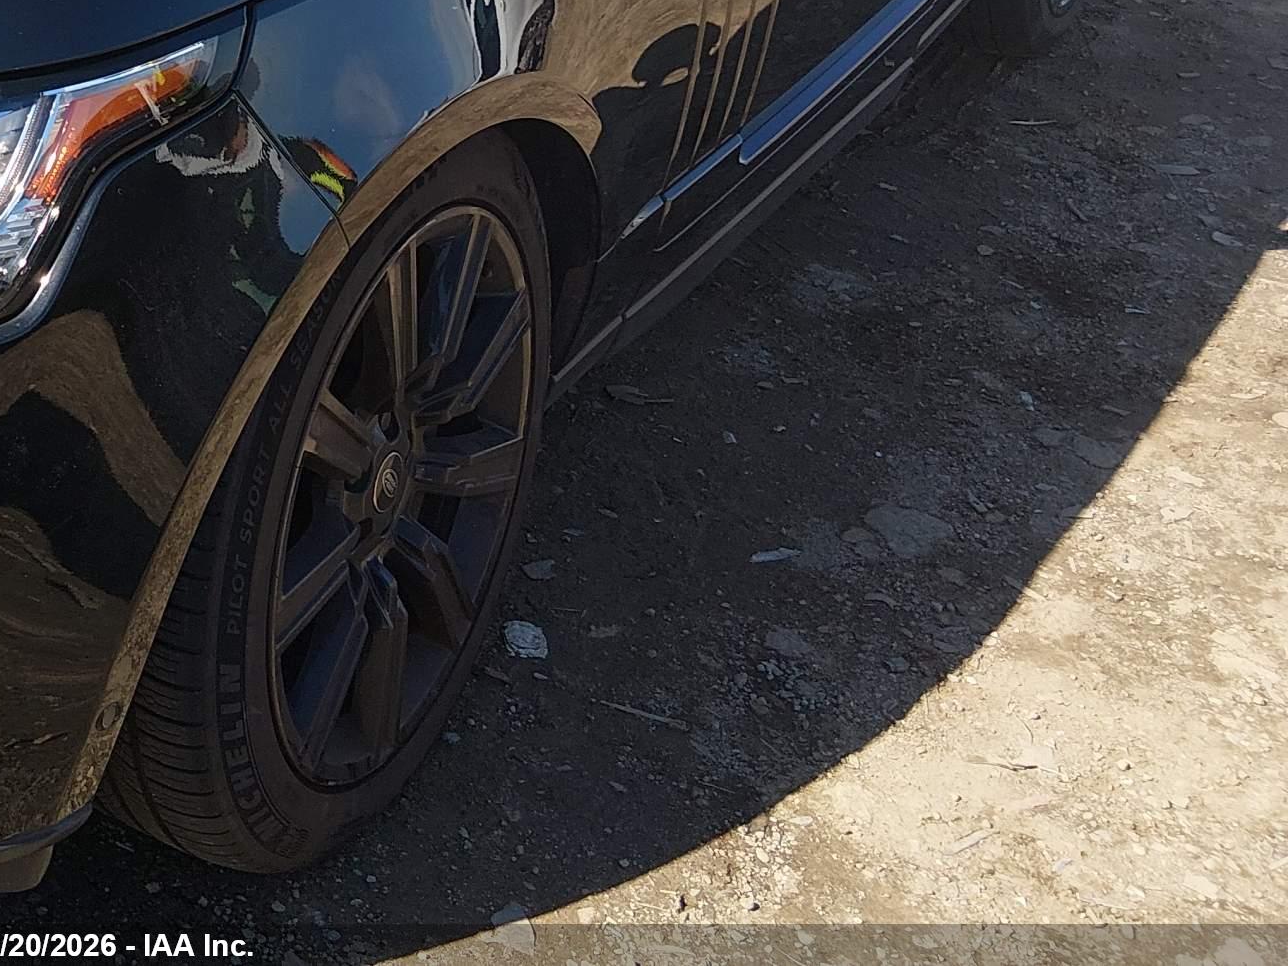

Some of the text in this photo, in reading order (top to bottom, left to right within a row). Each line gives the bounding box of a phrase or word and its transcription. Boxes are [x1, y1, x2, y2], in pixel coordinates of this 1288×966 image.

[226, 559, 248, 635] PILOT
[241, 451, 272, 545] SPORT
[268, 385, 294, 433] ALL
[217, 663, 284, 840] MICHELIN
